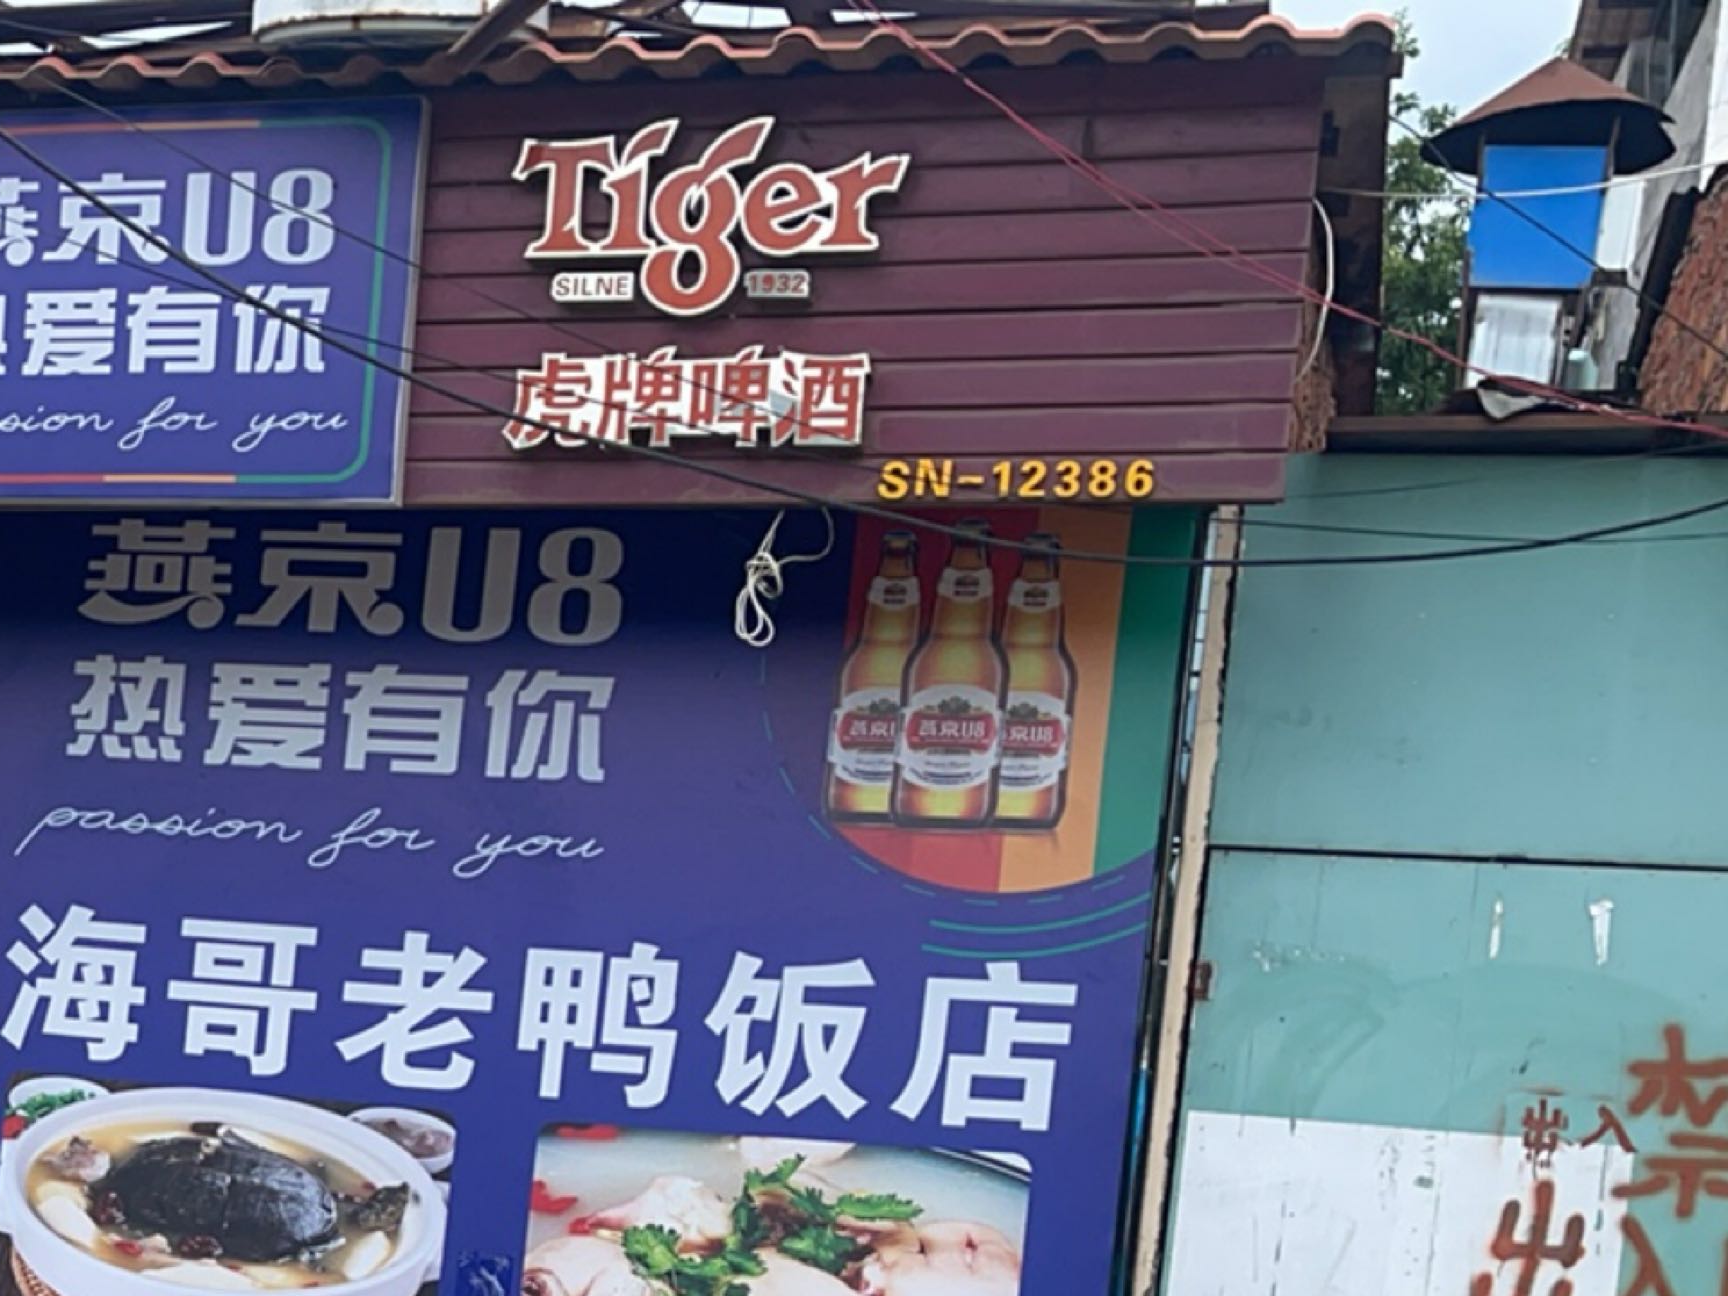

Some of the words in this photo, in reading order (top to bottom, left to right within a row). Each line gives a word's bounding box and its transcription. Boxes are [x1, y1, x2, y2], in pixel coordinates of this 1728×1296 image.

[512, 117, 910, 314] Tiger
[748, 273, 806, 294] 1932
[117, 396, 218, 450] for
[232, 410, 349, 453] you
[503, 346, 870, 448] 虎牌啤酒
[877, 458, 1155, 500] SN-12386
[77, 518, 625, 646] 燕京U8
[66, 654, 615, 783] 热爱有你
[16, 804, 302, 856] passion
[308, 807, 436, 868] for
[453, 836, 605, 878] you
[0, 903, 1081, 1131] 海哥老鸭饭店
